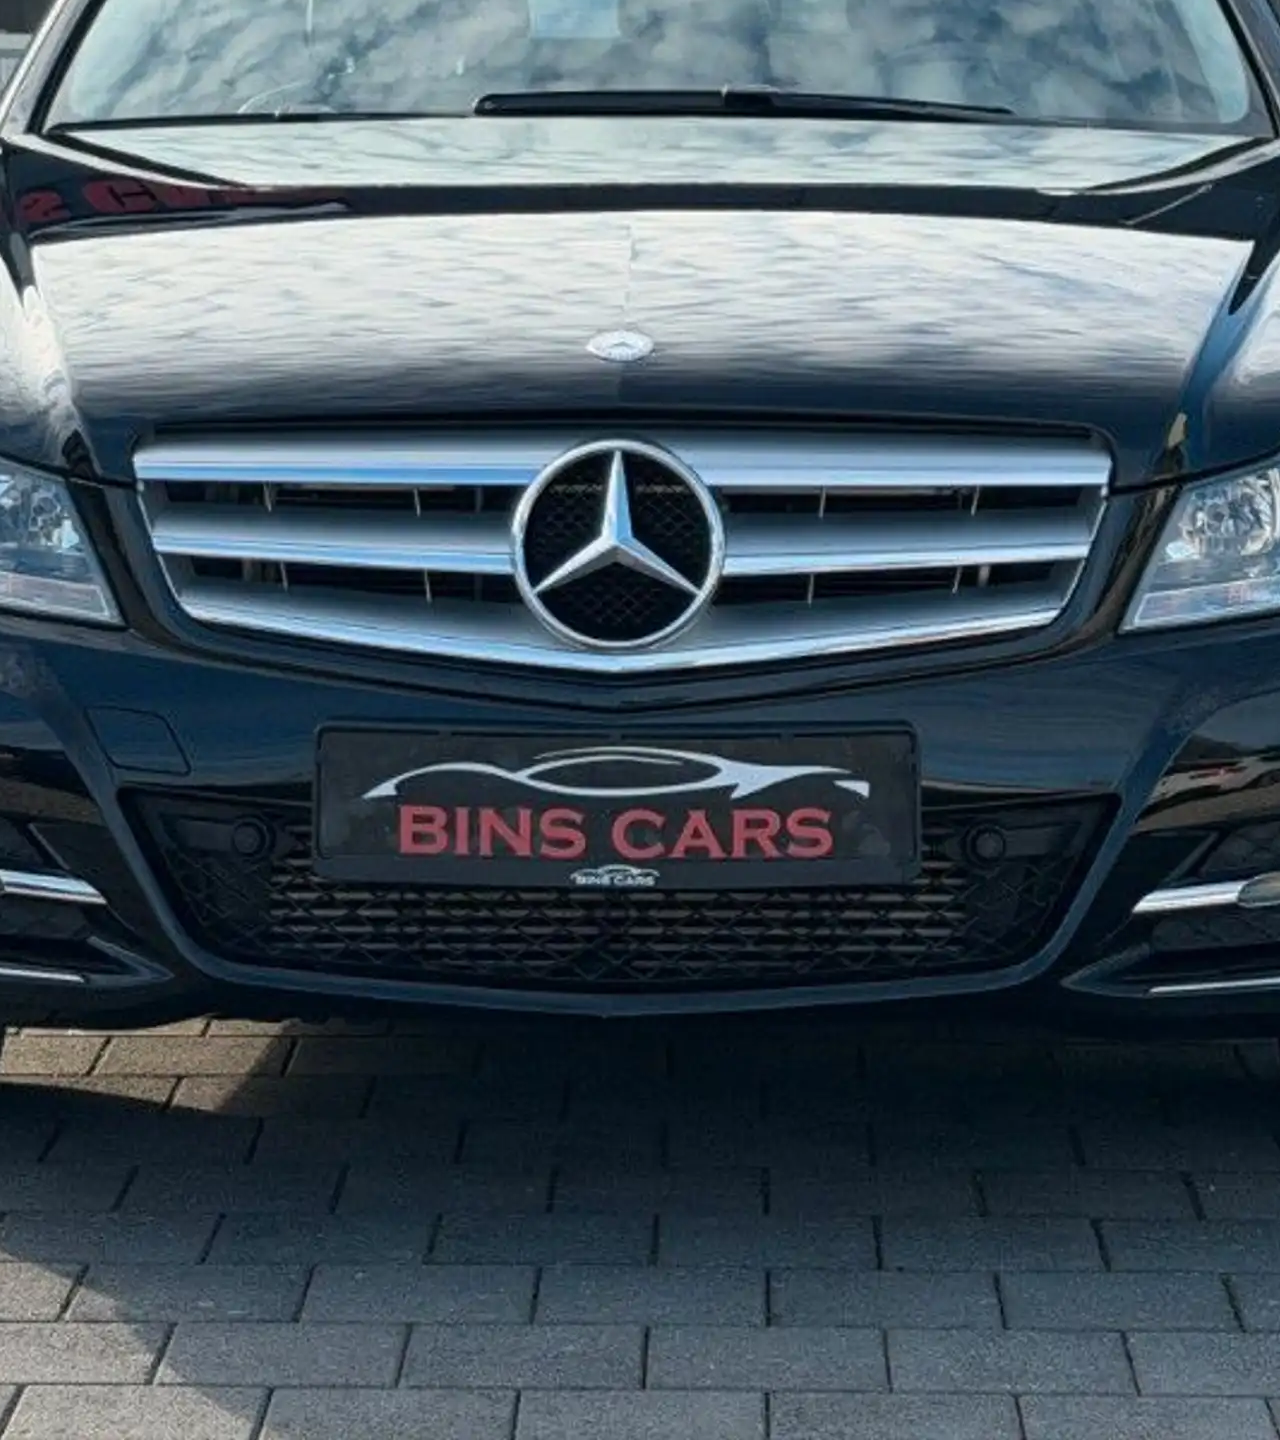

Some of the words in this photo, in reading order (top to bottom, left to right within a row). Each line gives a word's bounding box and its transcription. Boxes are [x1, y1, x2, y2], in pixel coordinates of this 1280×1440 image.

[398, 803, 587, 859] BINS
[611, 805, 835, 860] CARS
[613, 875, 656, 887] CARS
